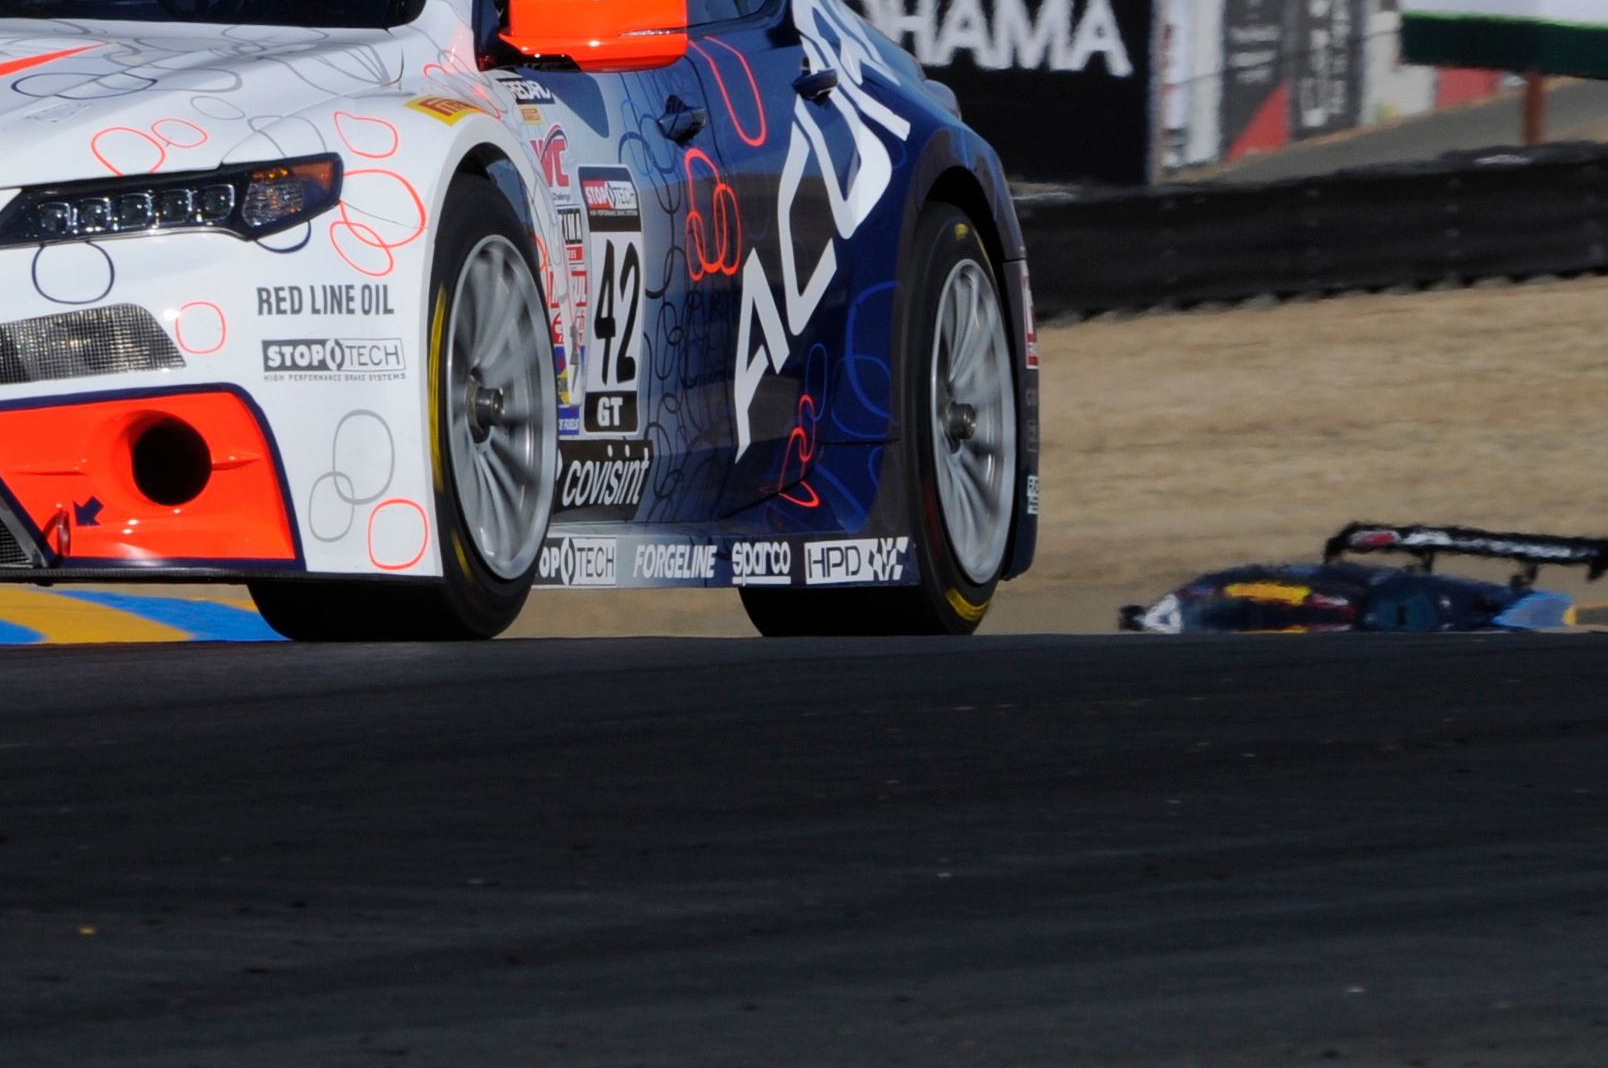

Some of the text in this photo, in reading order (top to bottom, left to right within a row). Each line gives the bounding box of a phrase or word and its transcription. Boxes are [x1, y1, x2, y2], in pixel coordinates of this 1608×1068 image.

[257, 283, 395, 316] RED LINE OIL
[594, 238, 641, 386] 42
[264, 371, 407, 383] HIGH PERFORMANCE BRAKE SYSTEMS
[597, 396, 624, 426] GT
[561, 444, 650, 507] covisint
[632, 541, 719, 579] FORGELINE
[732, 540, 791, 585] sparco
[808, 545, 861, 578] HPD
